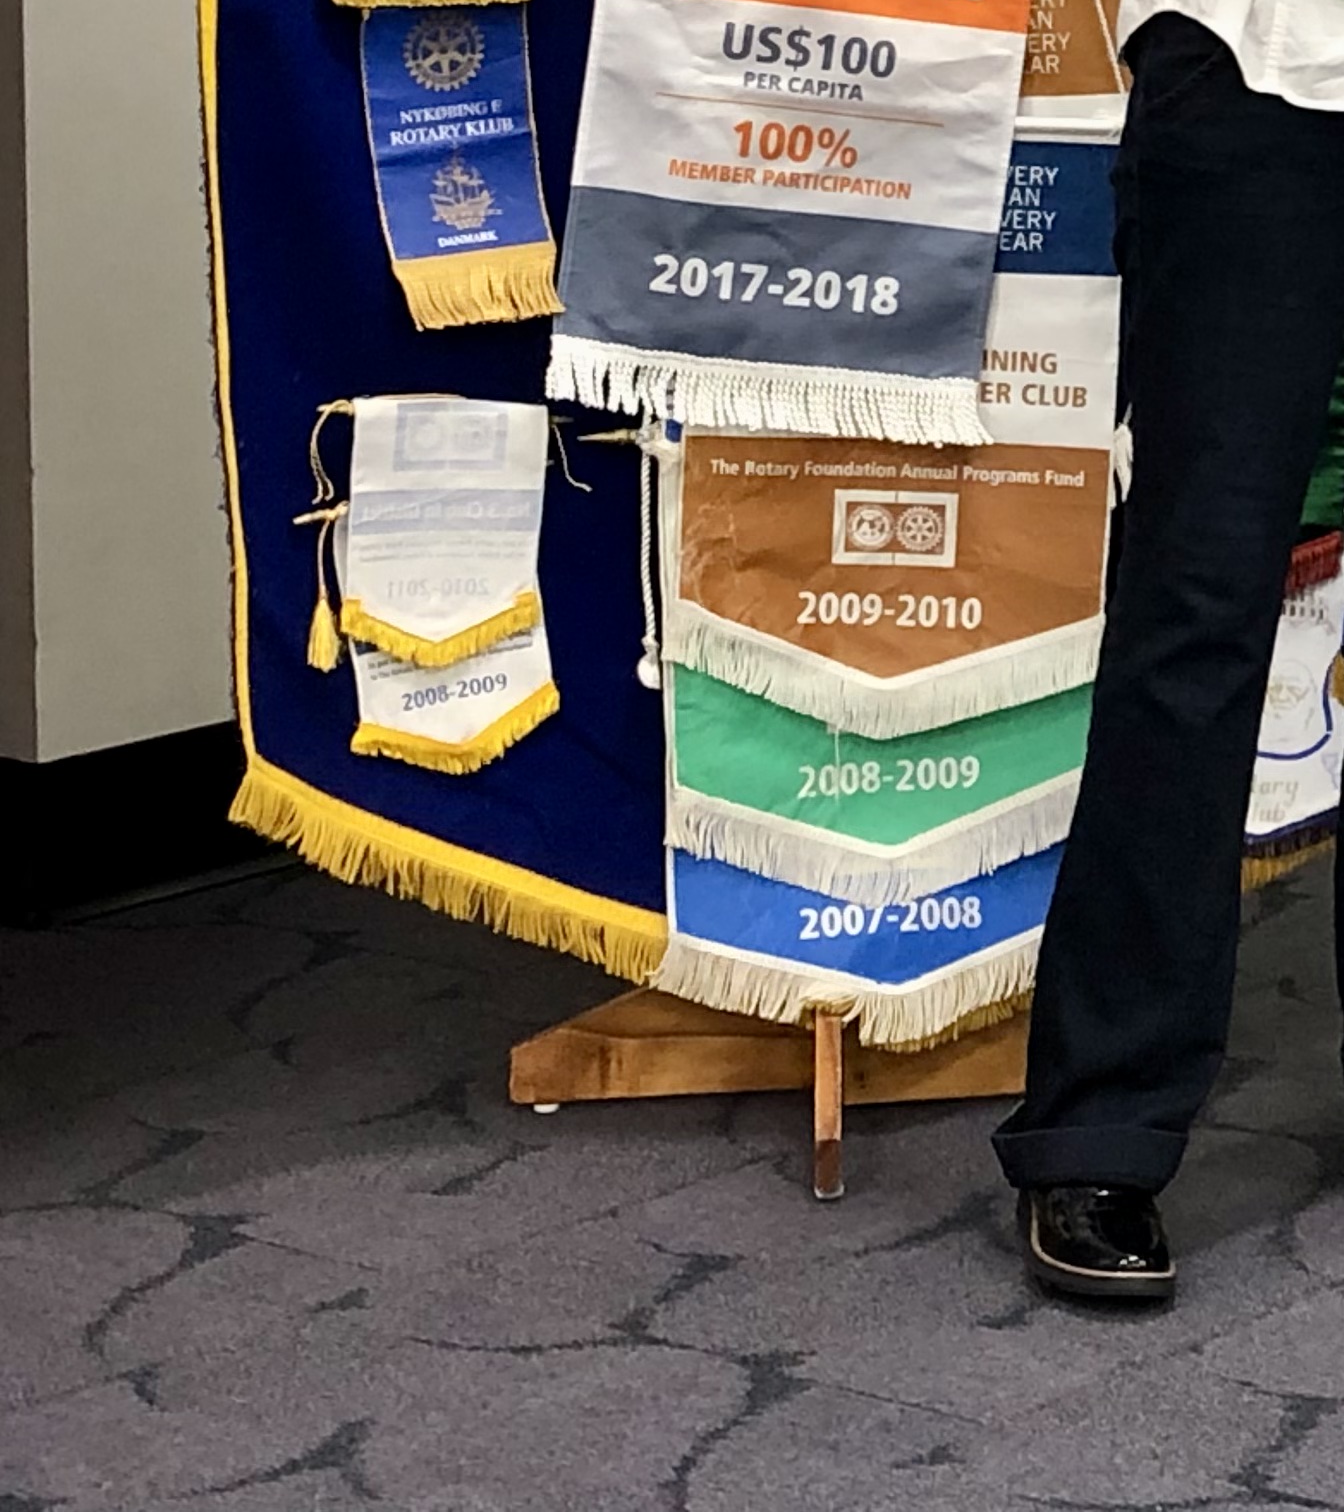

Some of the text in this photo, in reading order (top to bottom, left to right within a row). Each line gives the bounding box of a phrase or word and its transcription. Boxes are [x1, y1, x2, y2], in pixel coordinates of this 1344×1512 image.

[722, 22, 897, 78] US$100
[1026, 54, 1060, 74] AR
[743, 71, 864, 102] PER CAPITA
[390, 117, 515, 147] ROTARY KLUB
[733, 120, 858, 169] 100%
[668, 158, 912, 200] MEMBER PARTICIPATION
[437, 230, 499, 248] DANMARK
[648, 253, 902, 317] 2017-2018
[980, 381, 1088, 408] ER CLUB
[710, 459, 1085, 487] The Rotary Foundation Annual Programs Fund
[796, 591, 983, 630] 2009-2010
[401, 672, 508, 712] 2008-2009
[797, 755, 981, 799] 2008-2009
[799, 895, 983, 940] 2007-2008
